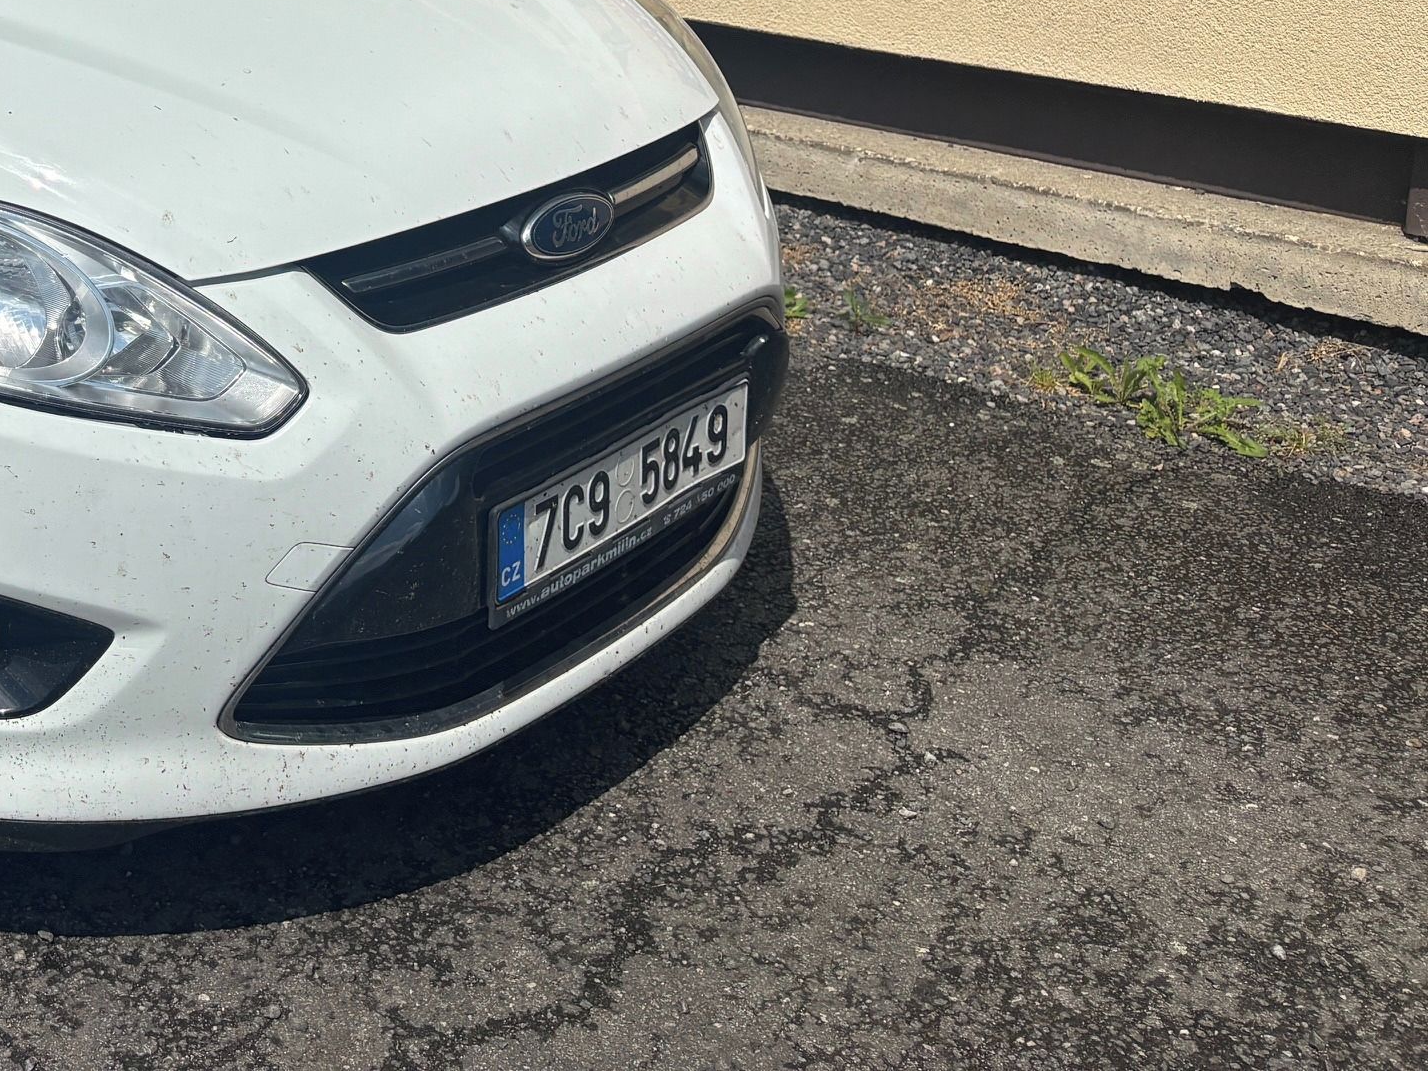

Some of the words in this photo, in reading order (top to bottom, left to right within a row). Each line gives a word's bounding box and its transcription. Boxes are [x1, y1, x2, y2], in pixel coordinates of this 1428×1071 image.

[552, 204, 599, 248] Ford
[533, 471, 610, 576] 7C9
[640, 403, 728, 504] 5849
[501, 560, 521, 587] CZ
